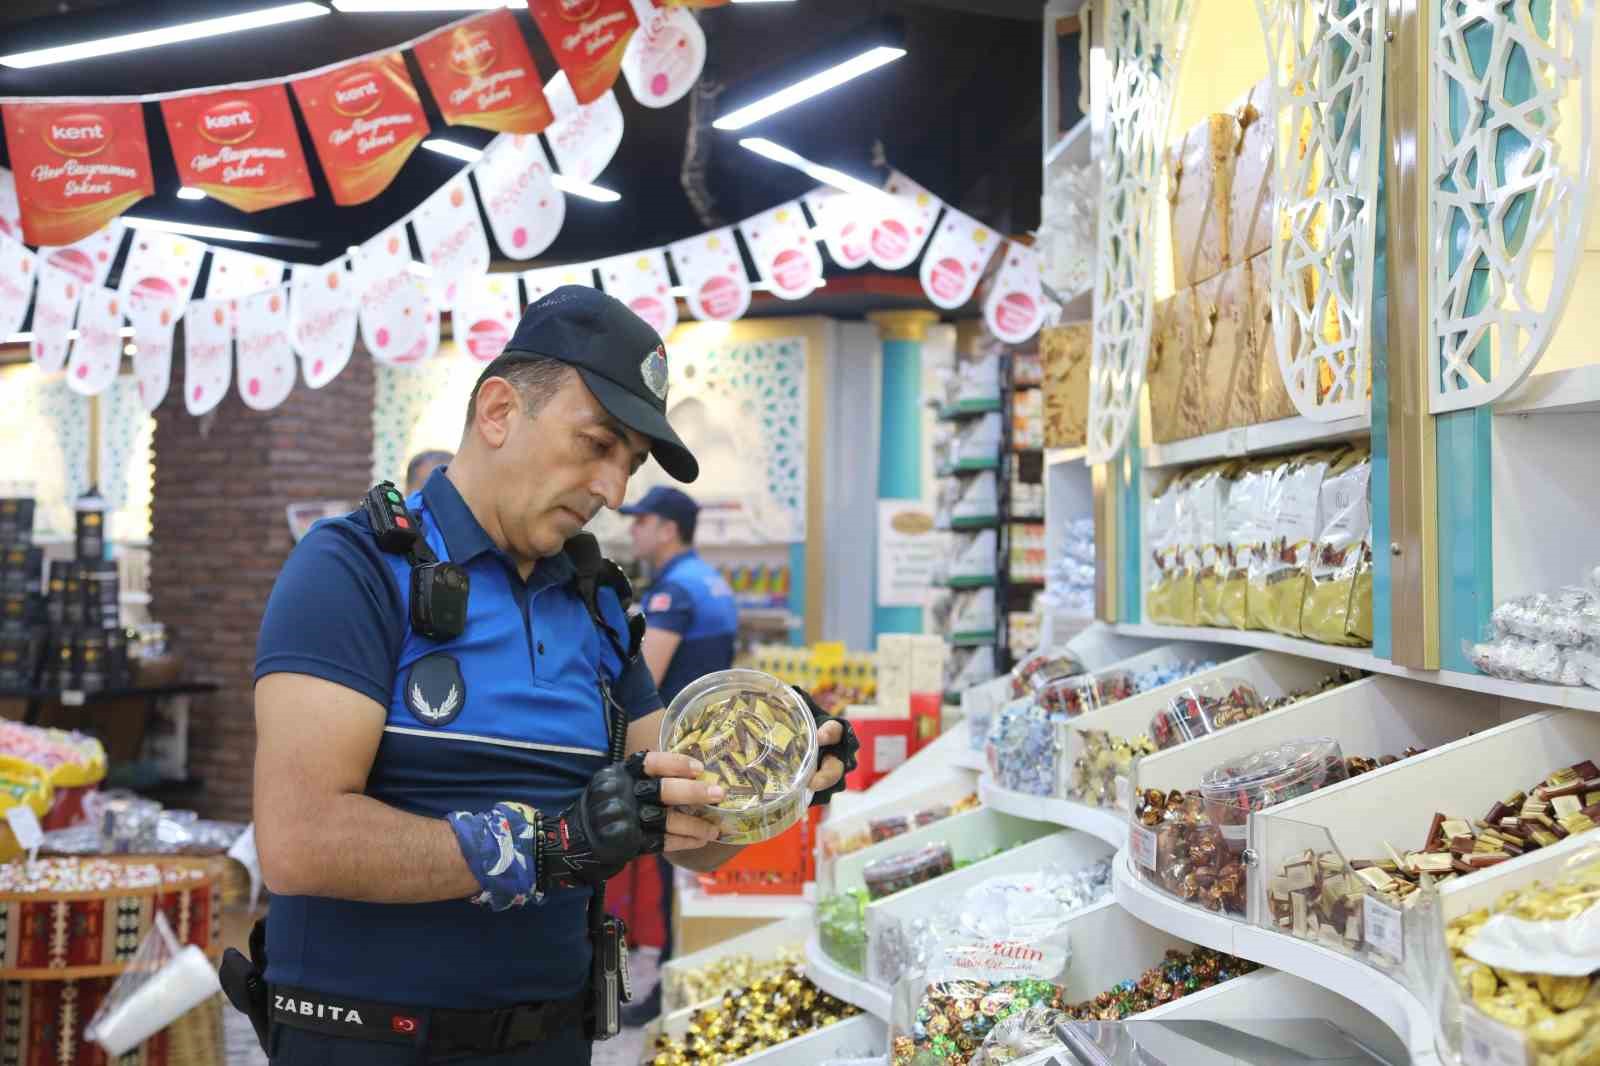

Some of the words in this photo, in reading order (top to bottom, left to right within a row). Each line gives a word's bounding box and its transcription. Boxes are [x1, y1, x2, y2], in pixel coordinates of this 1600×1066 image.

[335, 79, 379, 105] kent
[204, 109, 255, 129] kent
[51, 123, 105, 140] kent
[274, 995, 364, 1025] ZABITA
